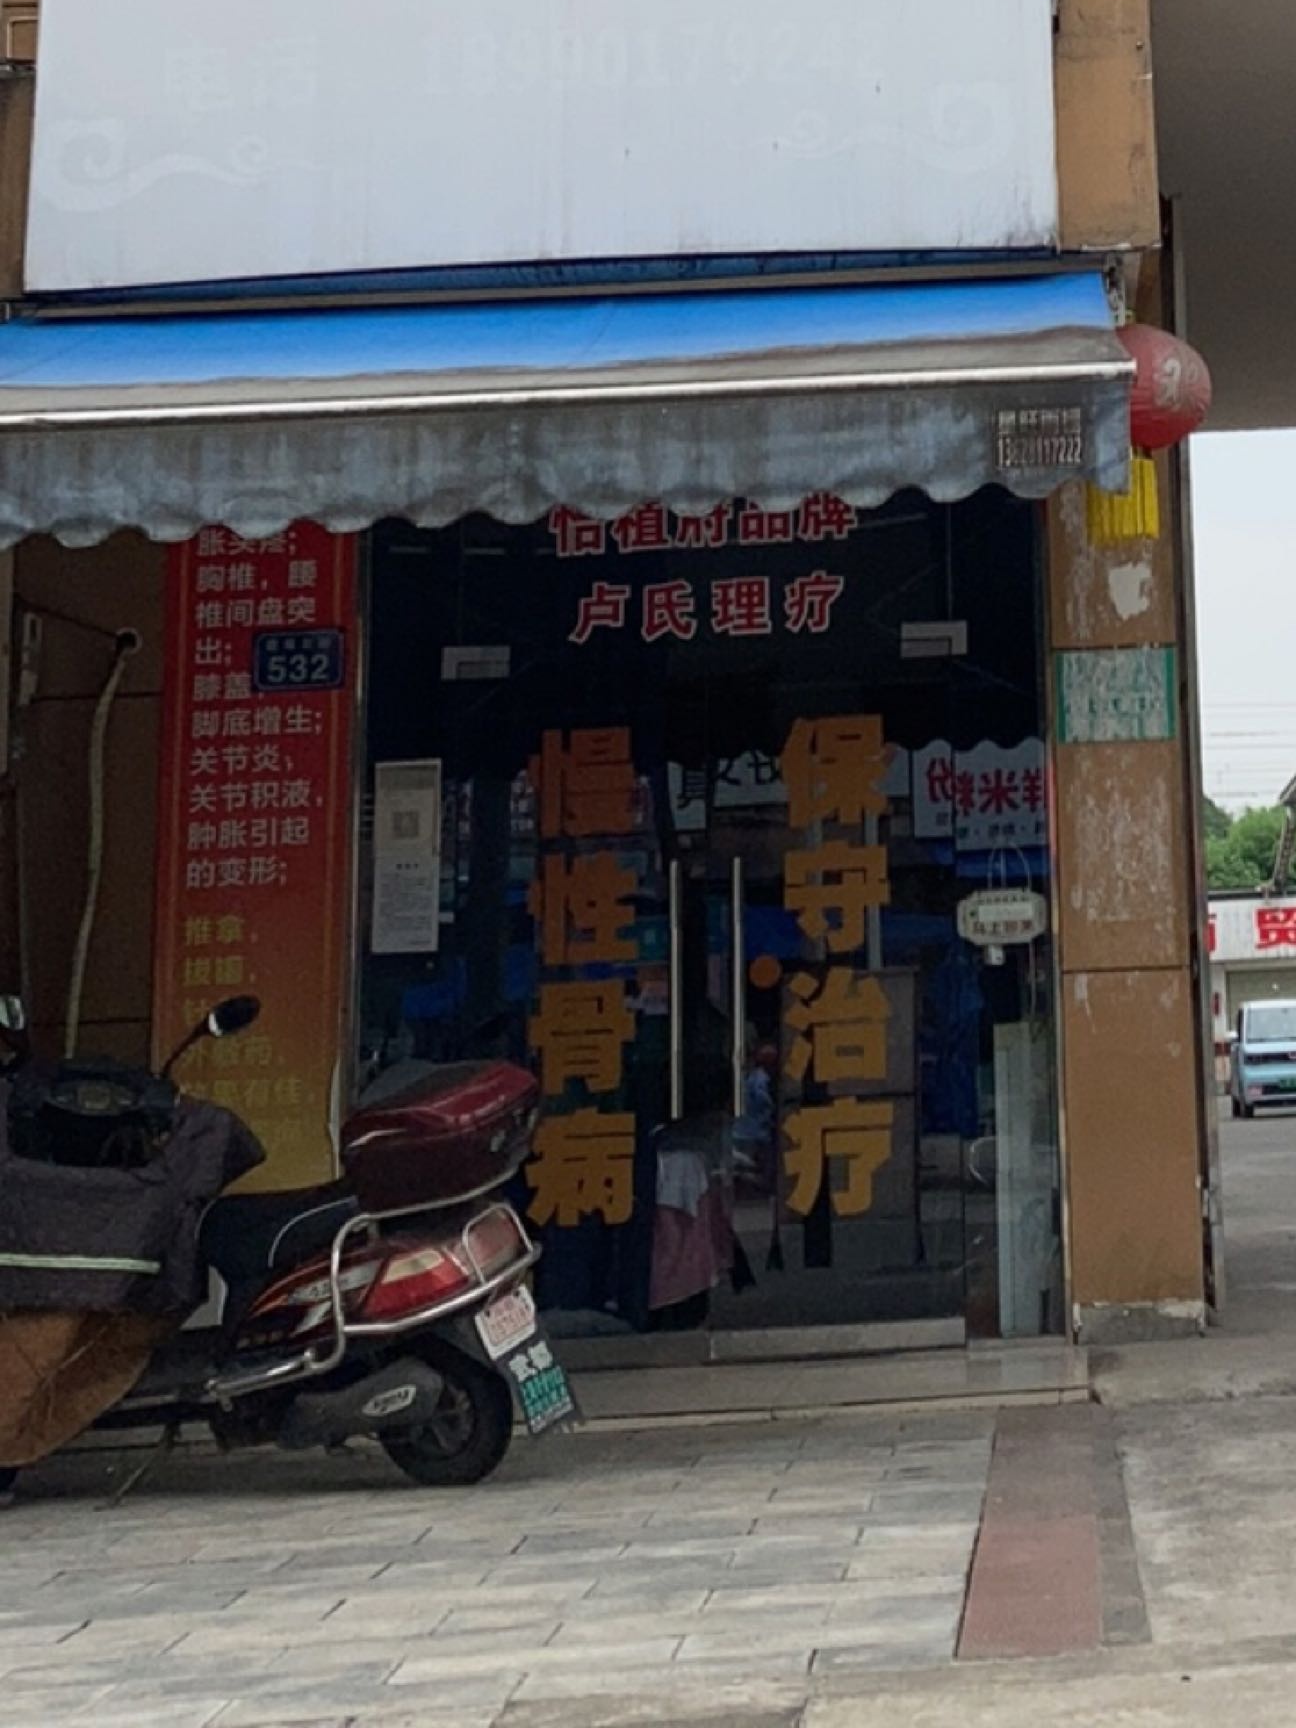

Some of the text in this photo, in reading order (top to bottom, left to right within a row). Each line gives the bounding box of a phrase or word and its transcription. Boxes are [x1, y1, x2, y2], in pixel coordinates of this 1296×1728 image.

[266, 653, 330, 683] 532
[567, 569, 846, 646] 卢氏理疗
[525, 725, 640, 1228] 慢性骨病
[781, 713, 898, 1219] 保守治疗
